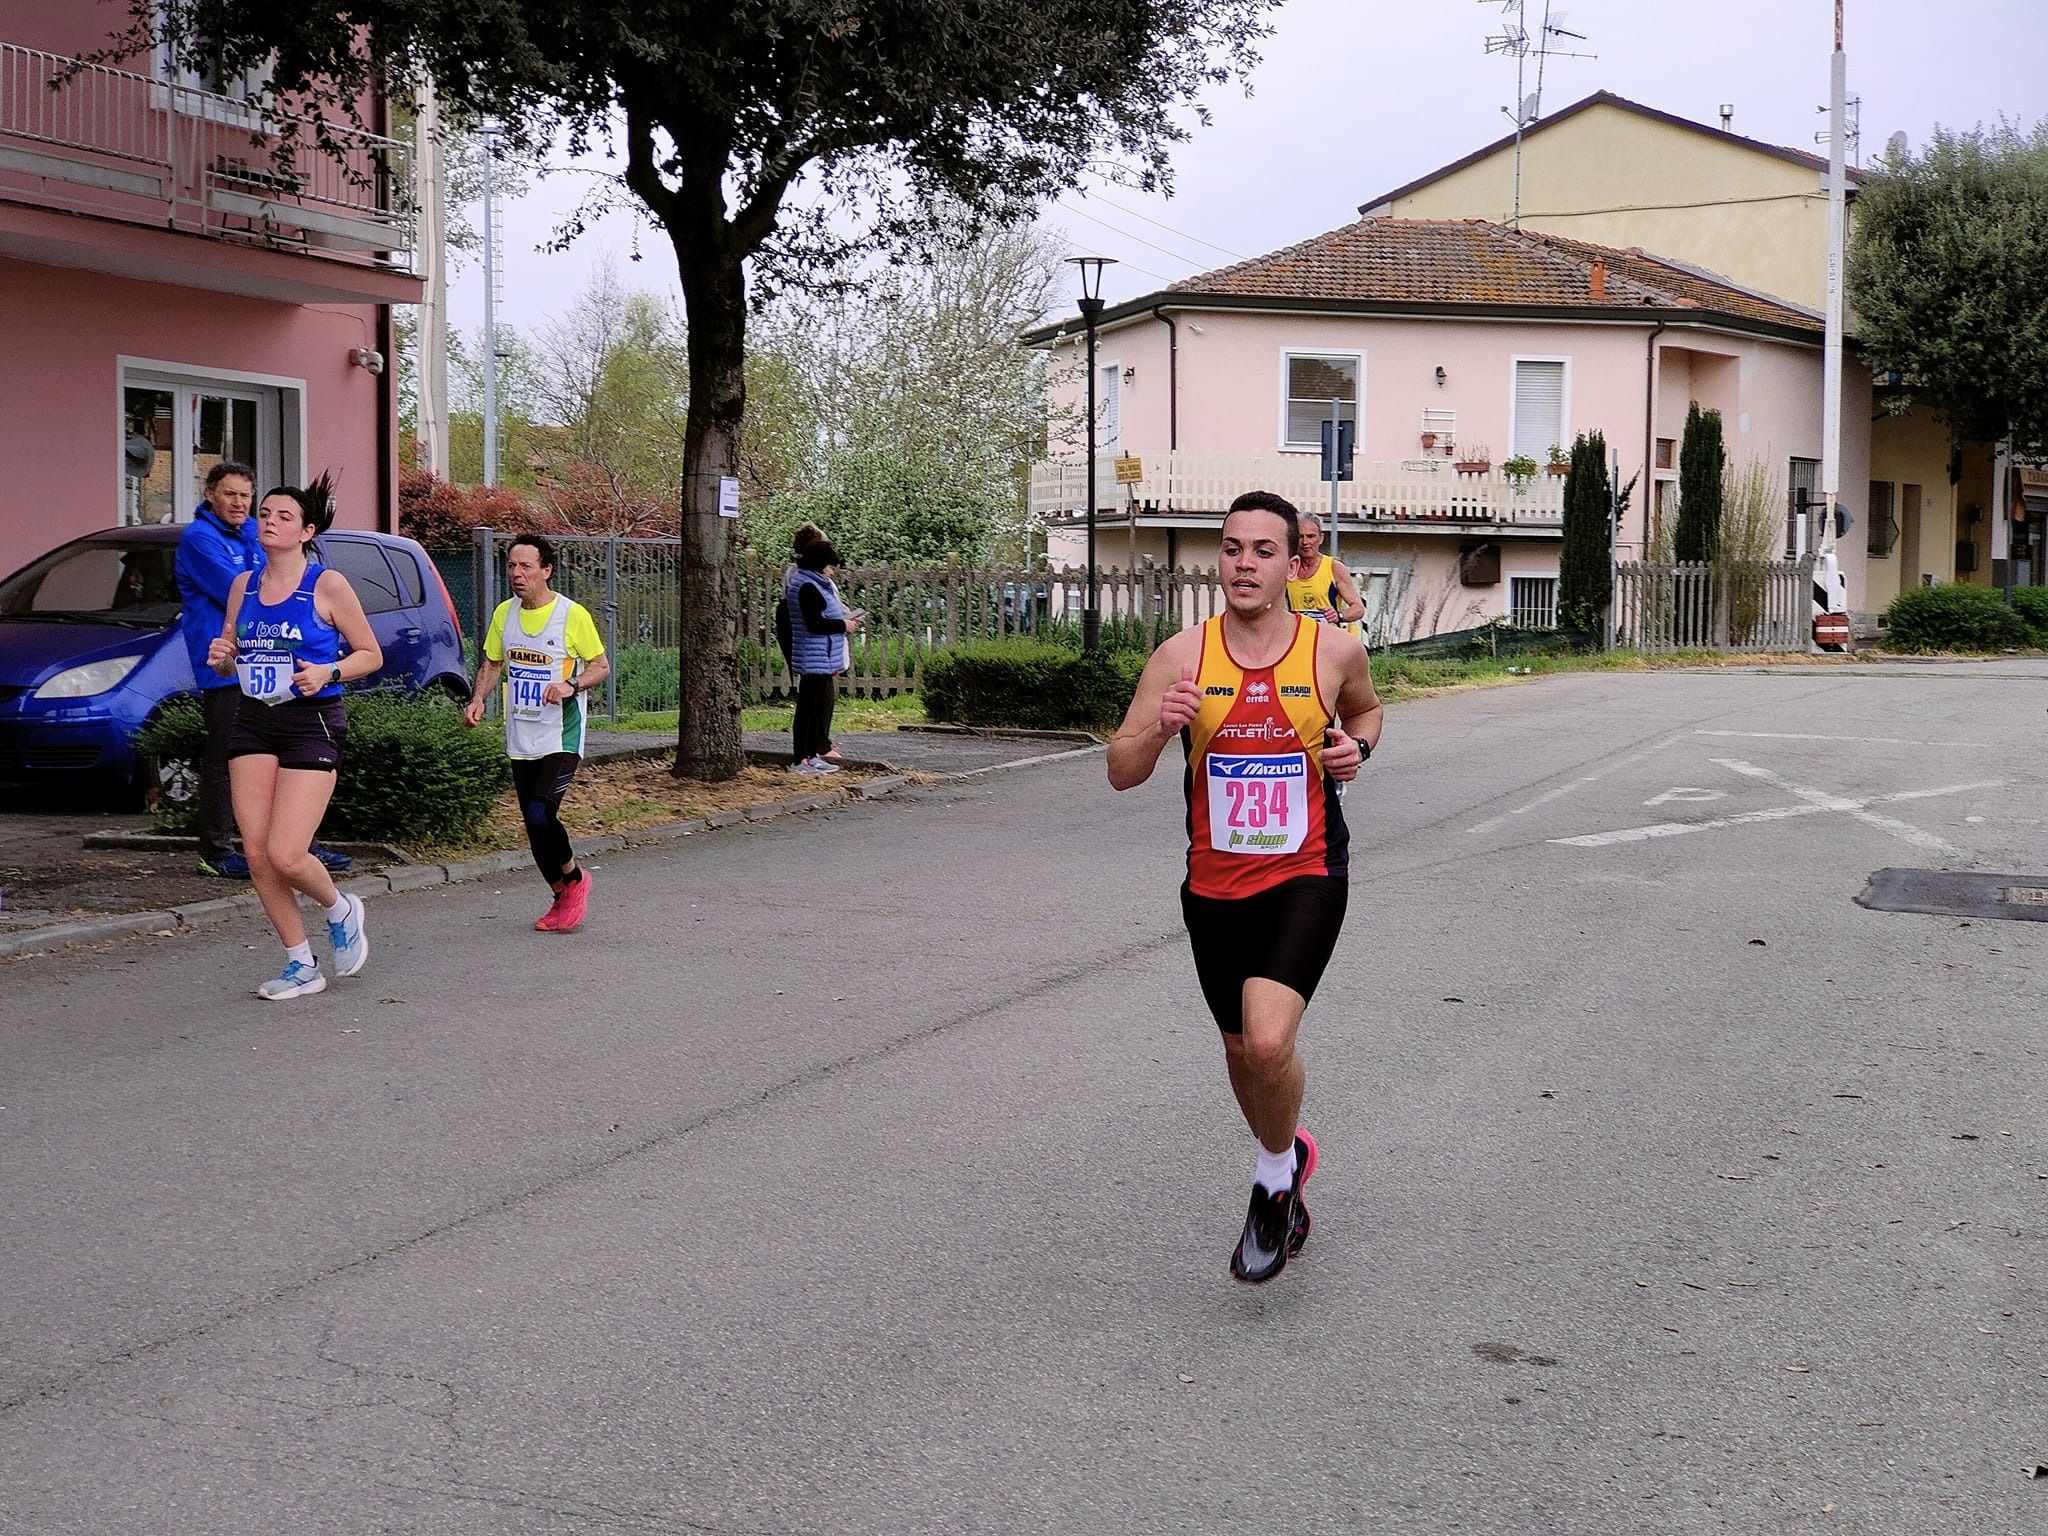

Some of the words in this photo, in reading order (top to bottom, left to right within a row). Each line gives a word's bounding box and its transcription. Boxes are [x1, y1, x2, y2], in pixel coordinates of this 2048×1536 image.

[250, 666, 276, 695] 58
[1280, 685, 1312, 694] BERARDI
[513, 680, 541, 707] 144
[1205, 686, 1235, 697] AVIS
[1241, 762, 1303, 776] MIZUNO
[1226, 781, 1289, 828] 234
